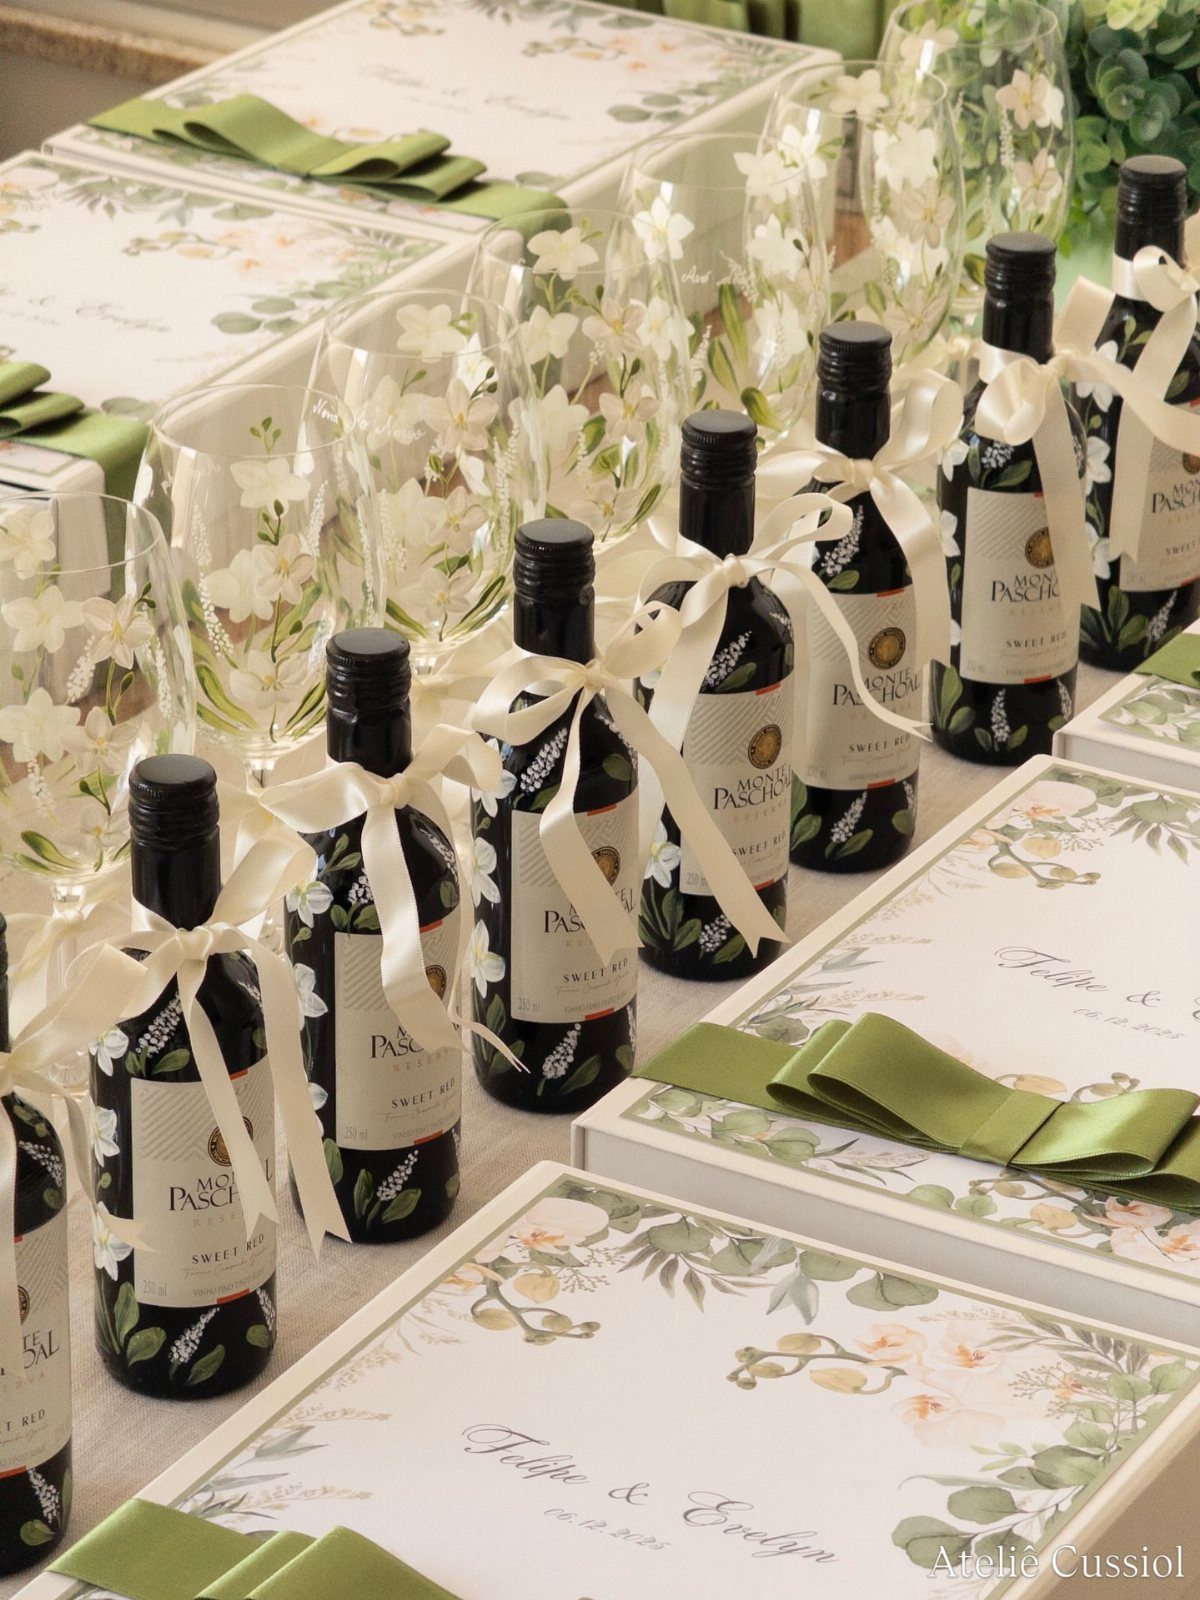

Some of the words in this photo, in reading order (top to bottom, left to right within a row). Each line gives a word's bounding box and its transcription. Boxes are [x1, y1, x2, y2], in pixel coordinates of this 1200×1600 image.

[1172, 478, 1200, 496] MON
[1151, 490, 1200, 513] PASCH
[991, 580, 1060, 603] PASCHO
[1014, 572, 1054, 587] MON
[848, 740, 888, 753] SWEET
[894, 733, 911, 747] RED
[713, 764, 792, 810] PASCHOAL
[737, 762, 786, 792] MONTE
[562, 967, 605, 984] SWEET
[612, 957, 628, 974] RED
[994, 946, 1109, 992] Felipe
[1126, 990, 1161, 1007] &
[391, 1090, 434, 1109] SWEET
[440, 1077, 456, 1094] RED
[344, 1126, 357, 1140] 250
[191, 1247, 238, 1265] SWEET
[246, 1234, 265, 1251] RED
[142, 1280, 157, 1294] 250
[22, 1408, 46, 1427] RED
[461, 1423, 590, 1485] Felipe
[608, 1482, 650, 1506] &
[682, 1491, 840, 1564] Evelyn
[543, 1508, 671, 1551] 06.12.2025
